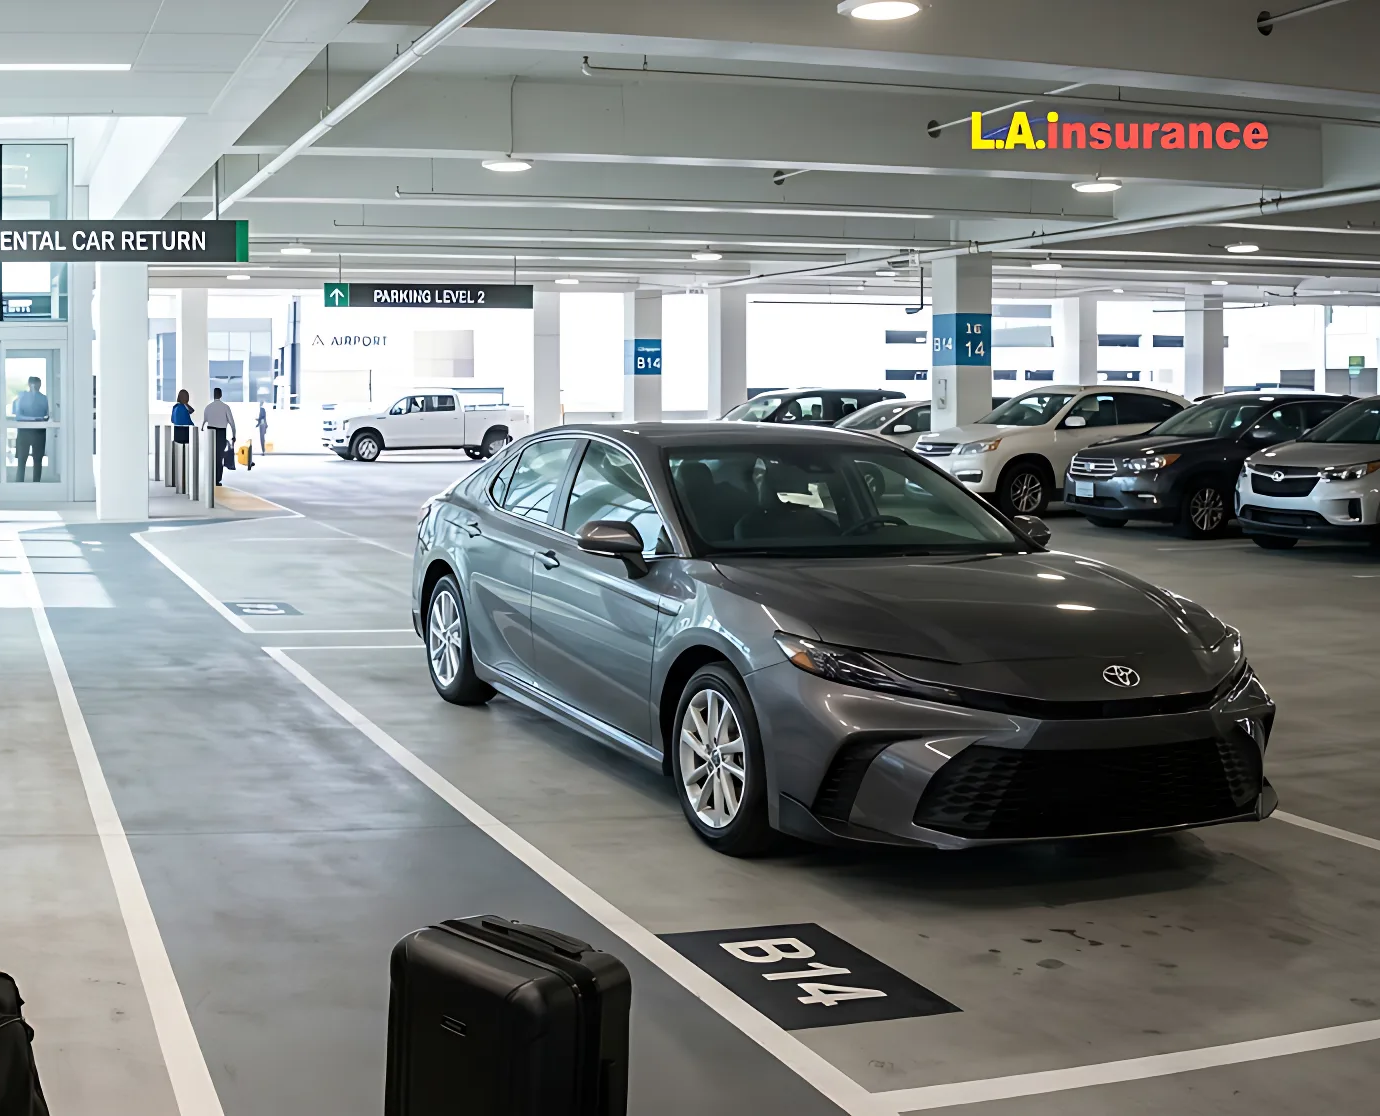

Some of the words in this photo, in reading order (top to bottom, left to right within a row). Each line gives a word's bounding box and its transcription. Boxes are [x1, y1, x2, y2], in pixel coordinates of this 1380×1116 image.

[72, 231, 115, 251] CAR
[121, 231, 206, 251] RETURN
[373, 289, 431, 304] PARKING
[435, 290, 475, 304] LEVEL
[477, 291, 485, 304] 2
[330, 335, 387, 347] AIRPORT
[965, 340, 985, 357] 14
[637, 356, 660, 369] B14
[719, 937, 887, 1006] B14
